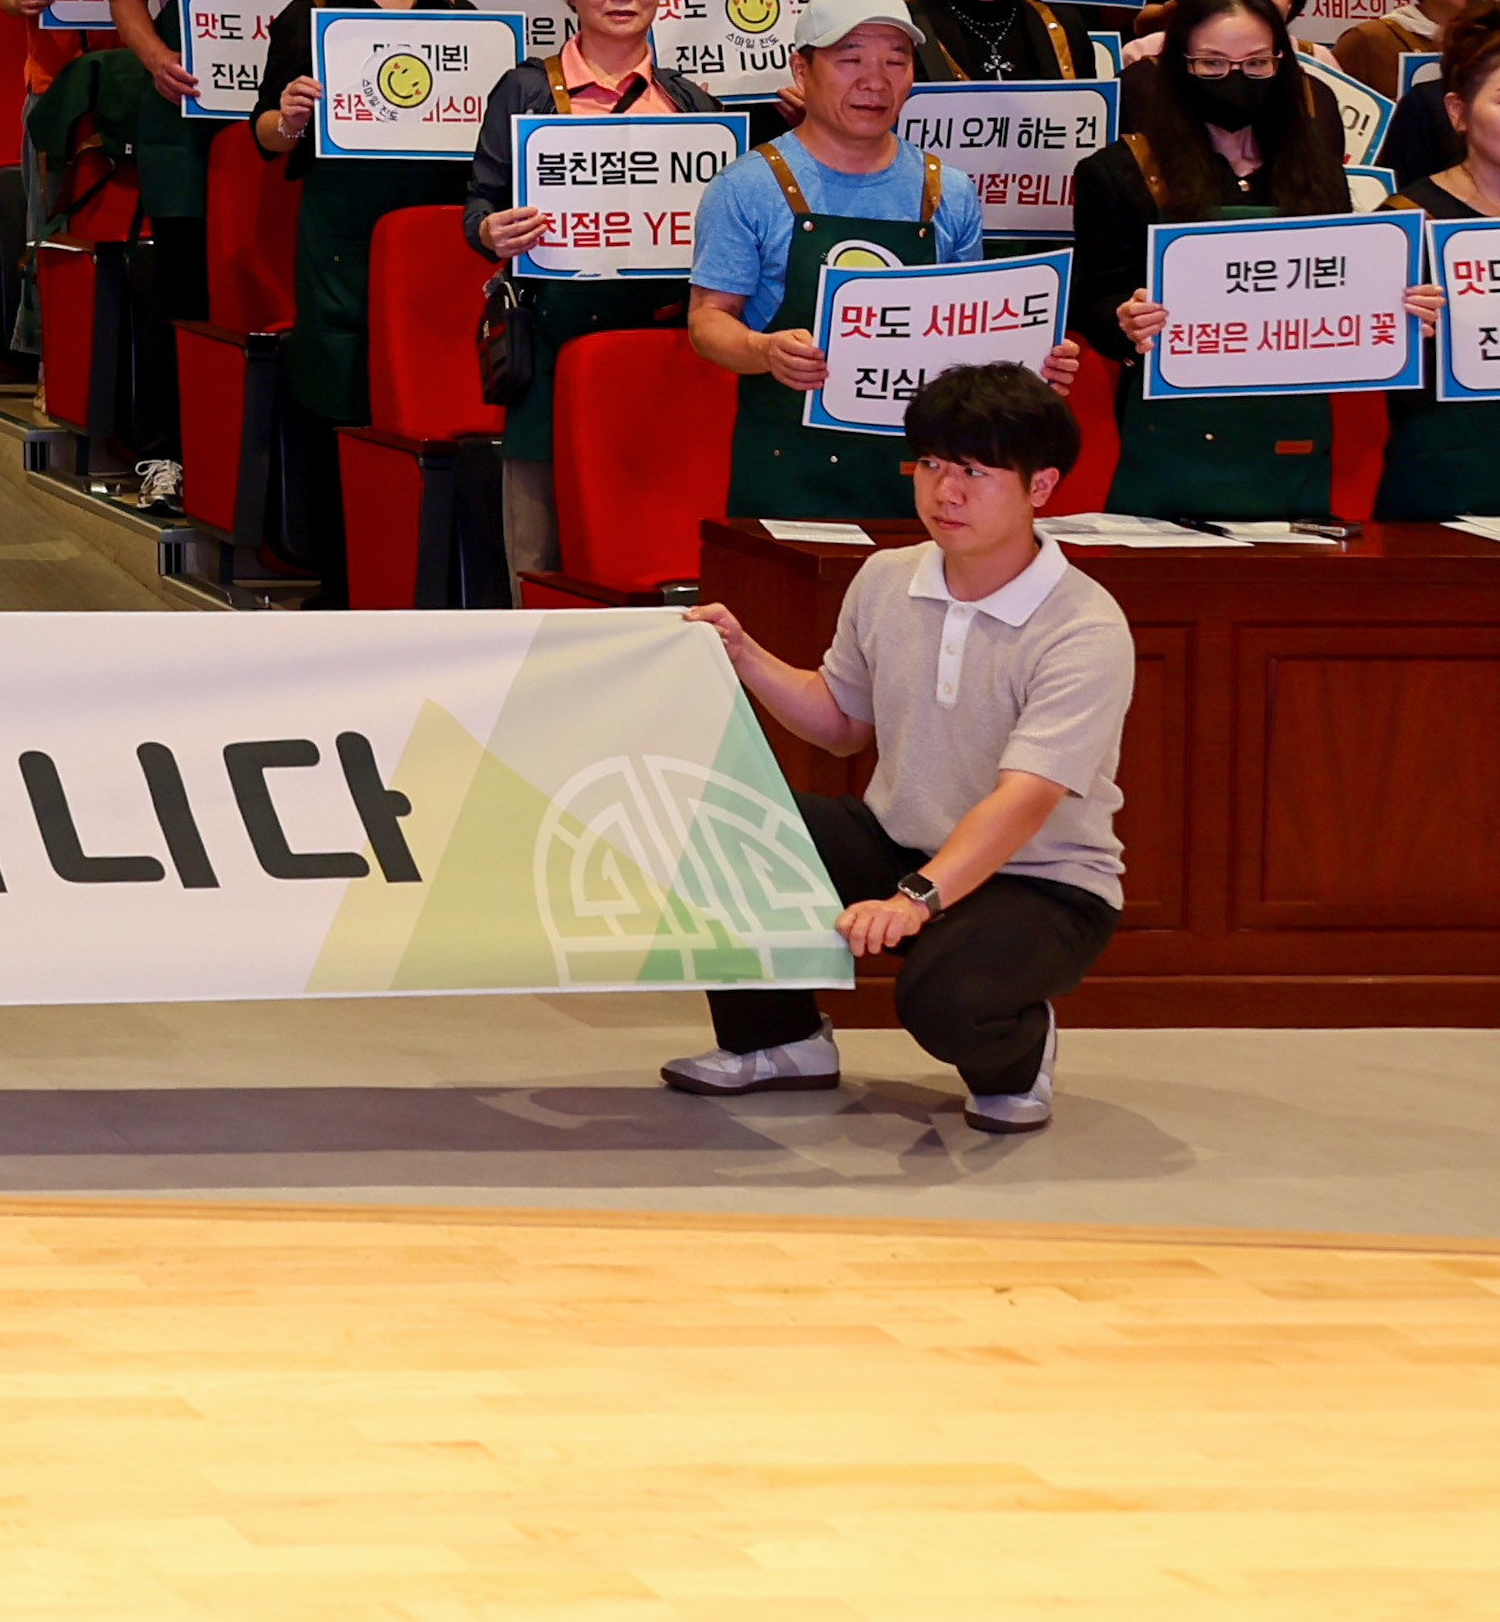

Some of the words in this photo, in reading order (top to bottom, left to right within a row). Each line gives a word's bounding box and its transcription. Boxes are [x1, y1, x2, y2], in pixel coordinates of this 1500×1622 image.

[196, 13, 243, 40] 맛도
[213, 63, 259, 91] 진심
[676, 45, 723, 74] 진심
[905, 118, 954, 150] 다시
[960, 117, 1010, 148] 오게
[1017, 118, 1066, 149] 하는
[1076, 116, 1096, 148] 건
[537, 151, 659, 186] 불친절은
[538, 212, 632, 248] 친절은
[1227, 260, 1278, 294] 맛은
[1287, 256, 1345, 289] 기본!
[841, 306, 910, 338] 맛도
[923, 293, 1049, 337] 서비스도
[1169, 322, 1248, 355] 친절은
[1257, 315, 1360, 351] 서비스의
[1371, 313, 1396, 345] 꽃
